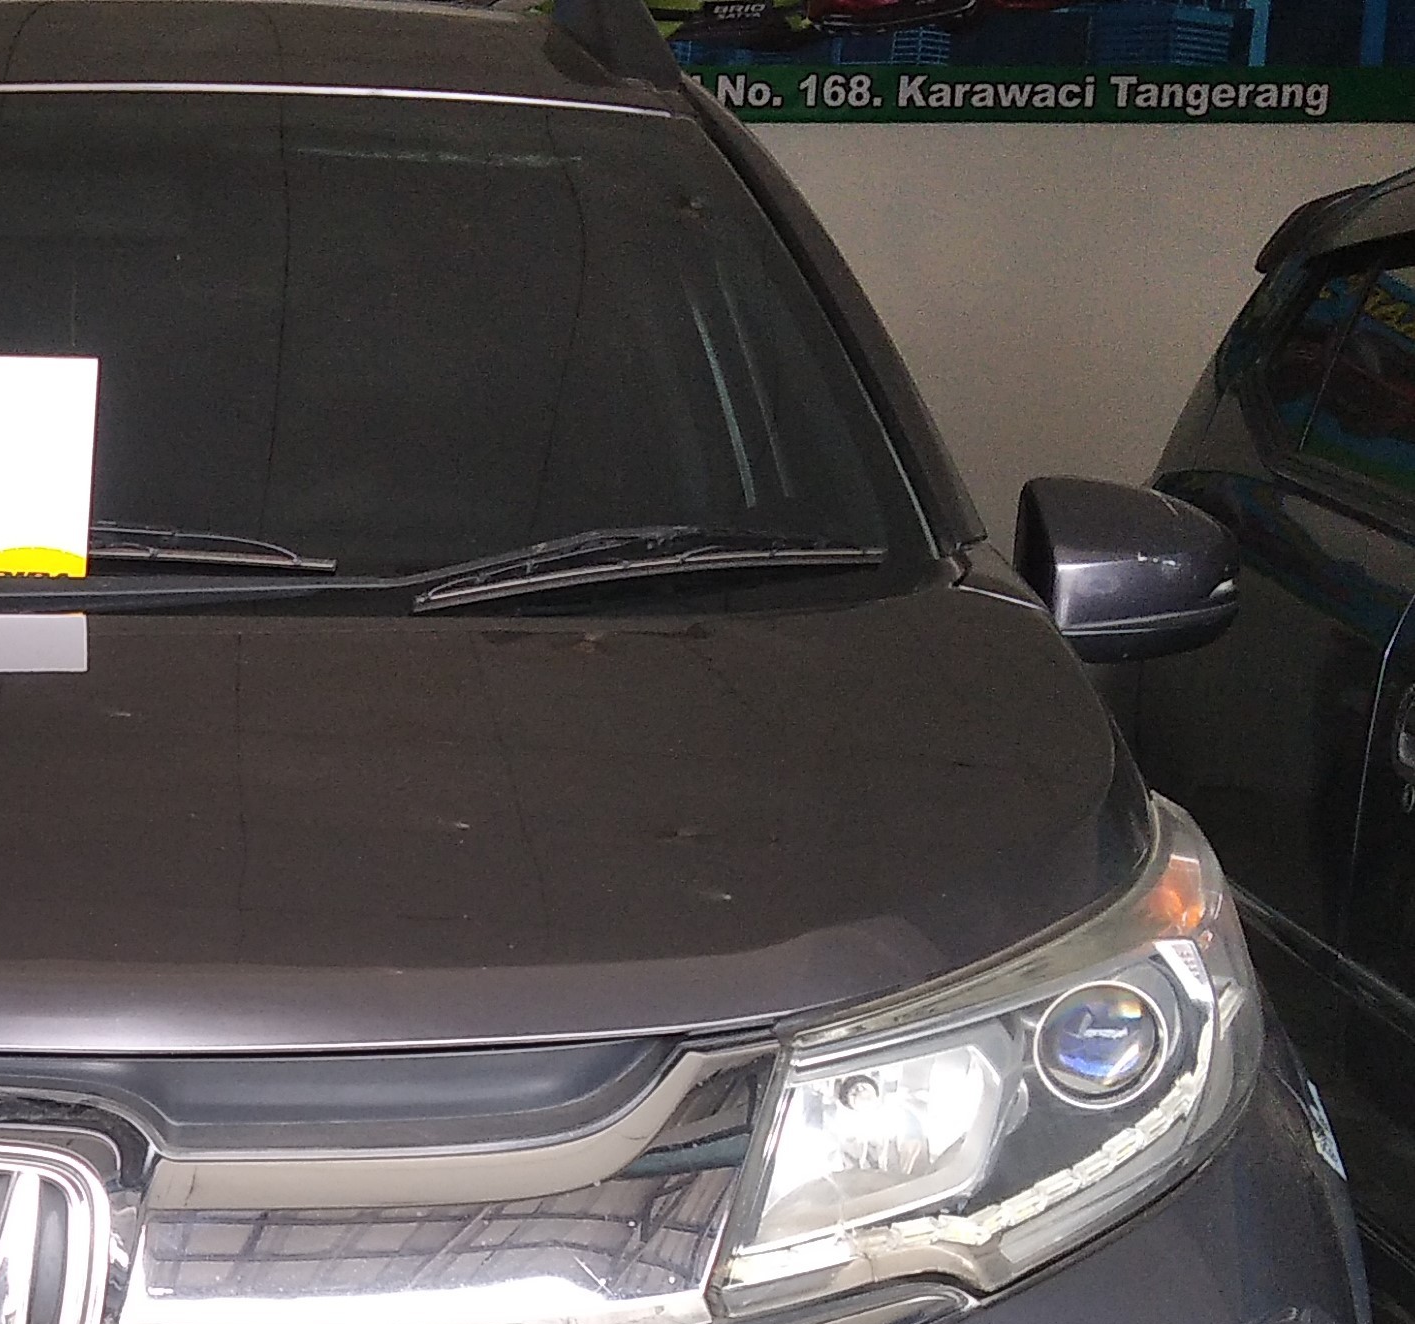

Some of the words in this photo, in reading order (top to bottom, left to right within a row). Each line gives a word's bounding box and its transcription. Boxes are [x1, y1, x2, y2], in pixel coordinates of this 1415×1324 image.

[713, 4, 765, 14] BRIO
[717, 74, 783, 107] No.
[799, 74, 883, 107] 168.
[897, 74, 1096, 108] Karawaci
[1111, 75, 1331, 116] Tangerang
